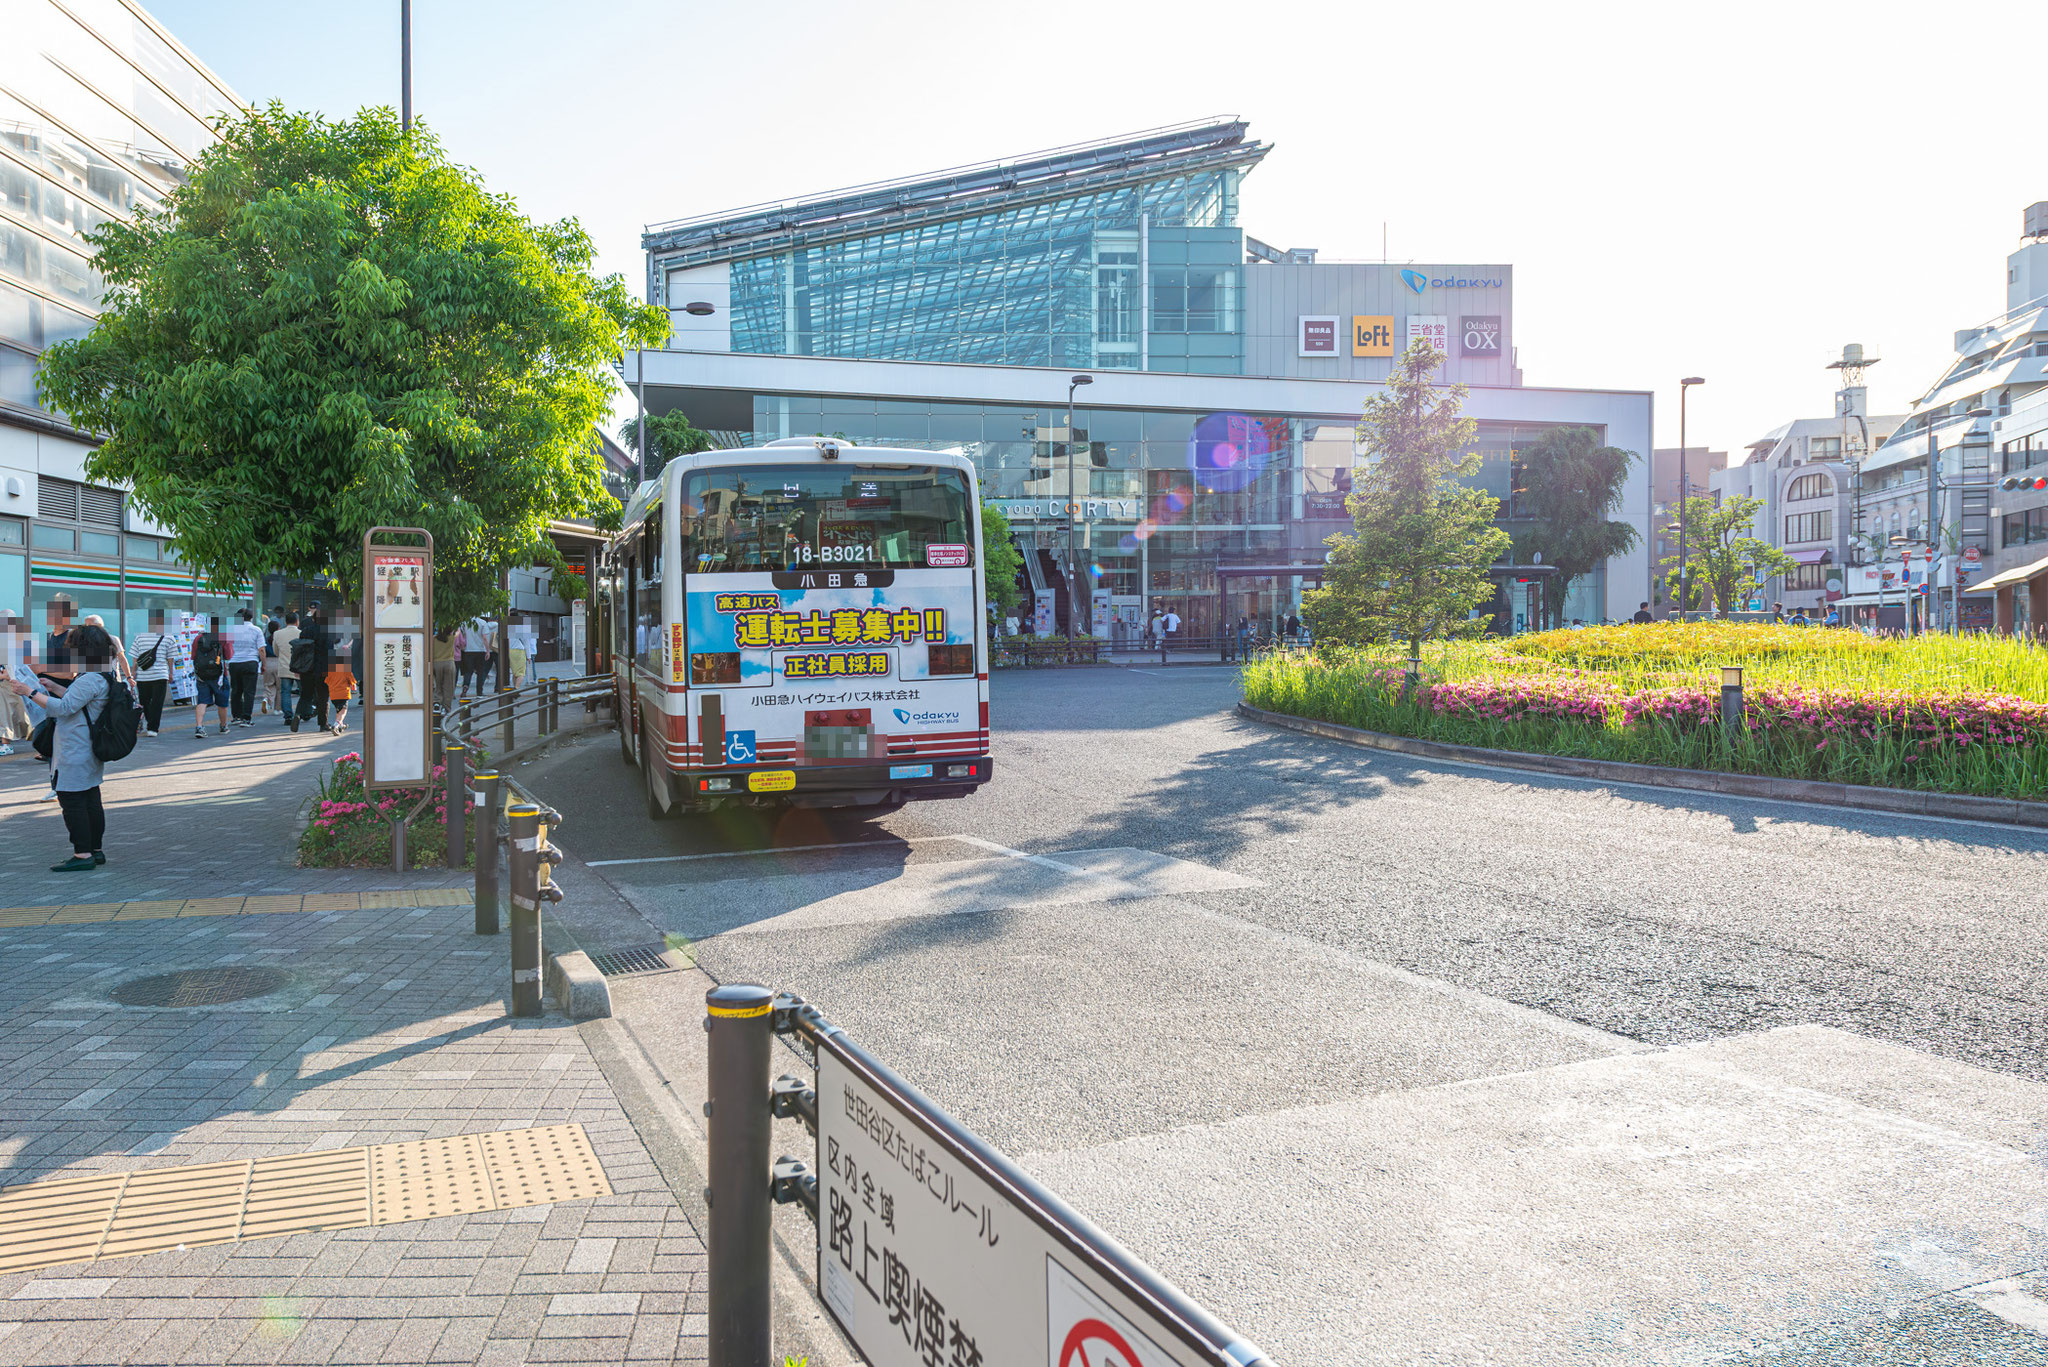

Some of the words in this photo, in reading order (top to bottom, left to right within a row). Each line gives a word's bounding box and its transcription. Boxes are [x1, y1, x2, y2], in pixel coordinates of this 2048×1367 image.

[1431, 275, 1503, 288] odakyu
[1410, 324, 1446, 336] 三省堂
[1466, 321, 1498, 333] Odakyu
[1464, 332, 1497, 350] OX
[996, 504, 1041, 515] KYODO
[1049, 500, 1130, 517] CORTY
[792, 546, 874, 563] 18-B3021
[801, 573, 868, 588] 小田急
[719, 596, 778, 610] 高速バス
[384, 643, 395, 704] ありがとうございます
[786, 655, 887, 676] 正社員採用
[751, 690, 921, 706] 小田急ハイウェイバス株式会社
[913, 711, 959, 720] odakyu
[844, 1083, 999, 1247] 世田谷区たばこルール
[828, 1135, 895, 1235] 区内全域
